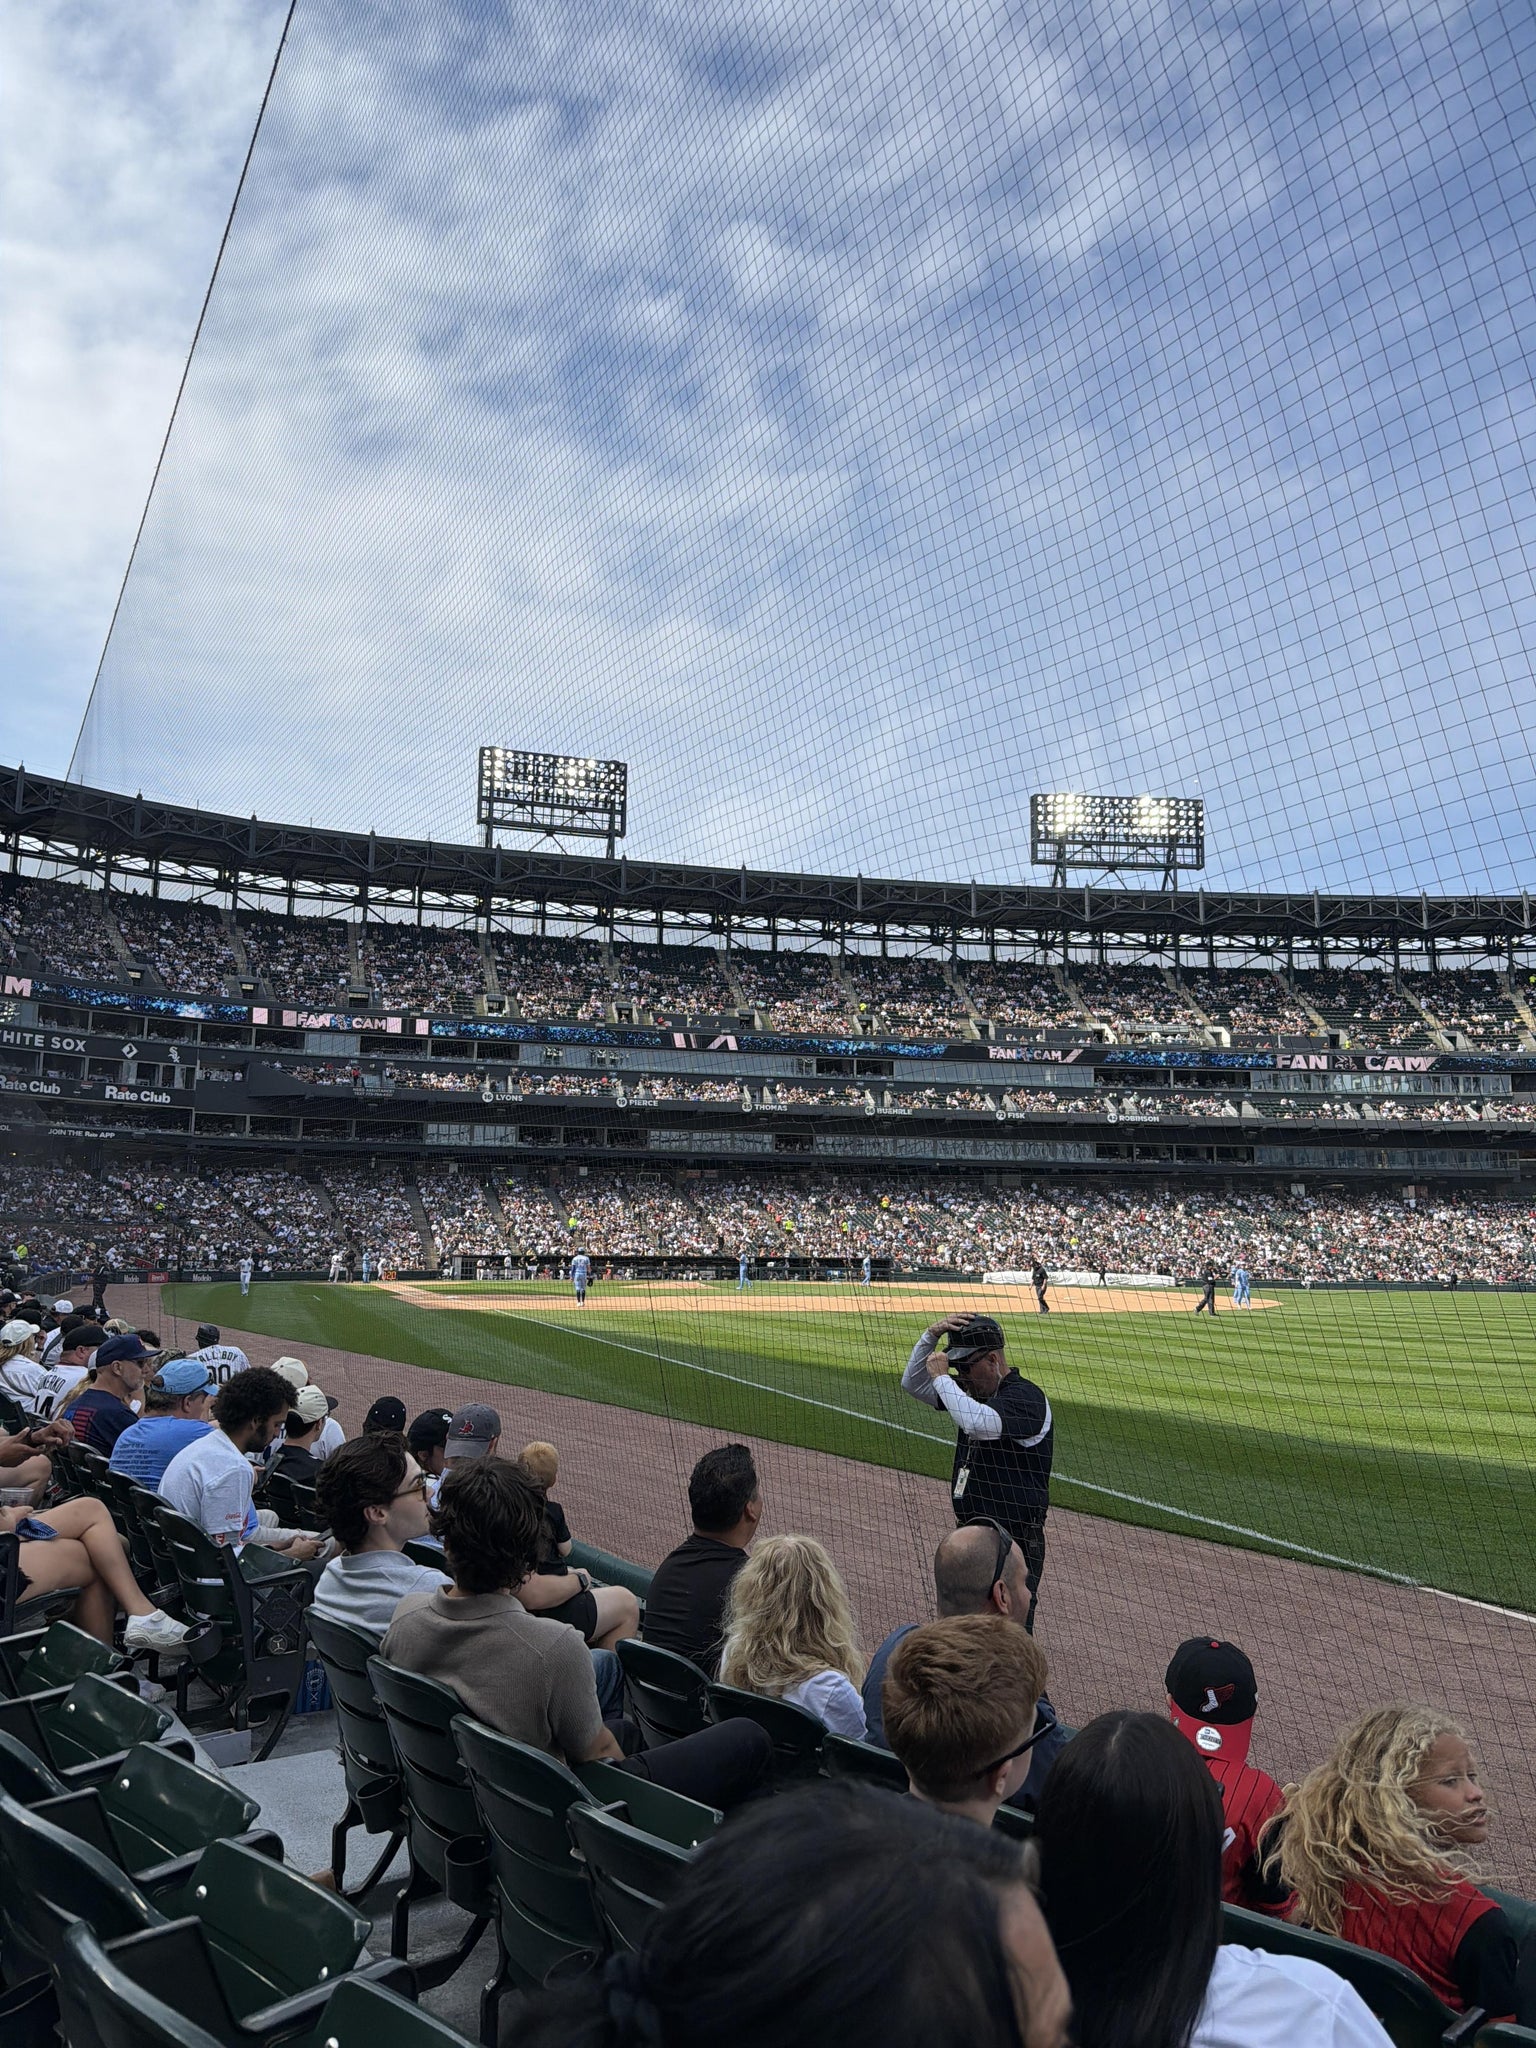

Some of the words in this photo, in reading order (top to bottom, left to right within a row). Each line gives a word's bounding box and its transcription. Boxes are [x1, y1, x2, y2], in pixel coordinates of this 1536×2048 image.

[0, 975, 32, 997] M
[352, 1017, 387, 1030] CAM
[0, 1030, 45, 1047] HITE
[51, 1037, 86, 1052] SOX
[989, 1047, 1016, 1059] FAN
[1033, 1050, 1062, 1060] CAM
[1276, 1055, 1328, 1070] FAN
[1364, 1055, 1428, 1071] CAM
[29, 1081, 61, 1095] Club
[105, 1085, 138, 1101] Rate
[140, 1091, 171, 1104] Club
[496, 1094, 523, 1102] LYONS
[754, 1104, 788, 1112] THOMAS
[877, 1107, 913, 1115] BUEHRLE
[1119, 1115, 1159, 1123] ROBINSON
[192, 1273, 212, 1282] Modelo
[198, 1351, 218, 1363] ALL
[221, 1350, 239, 1362] BOY
